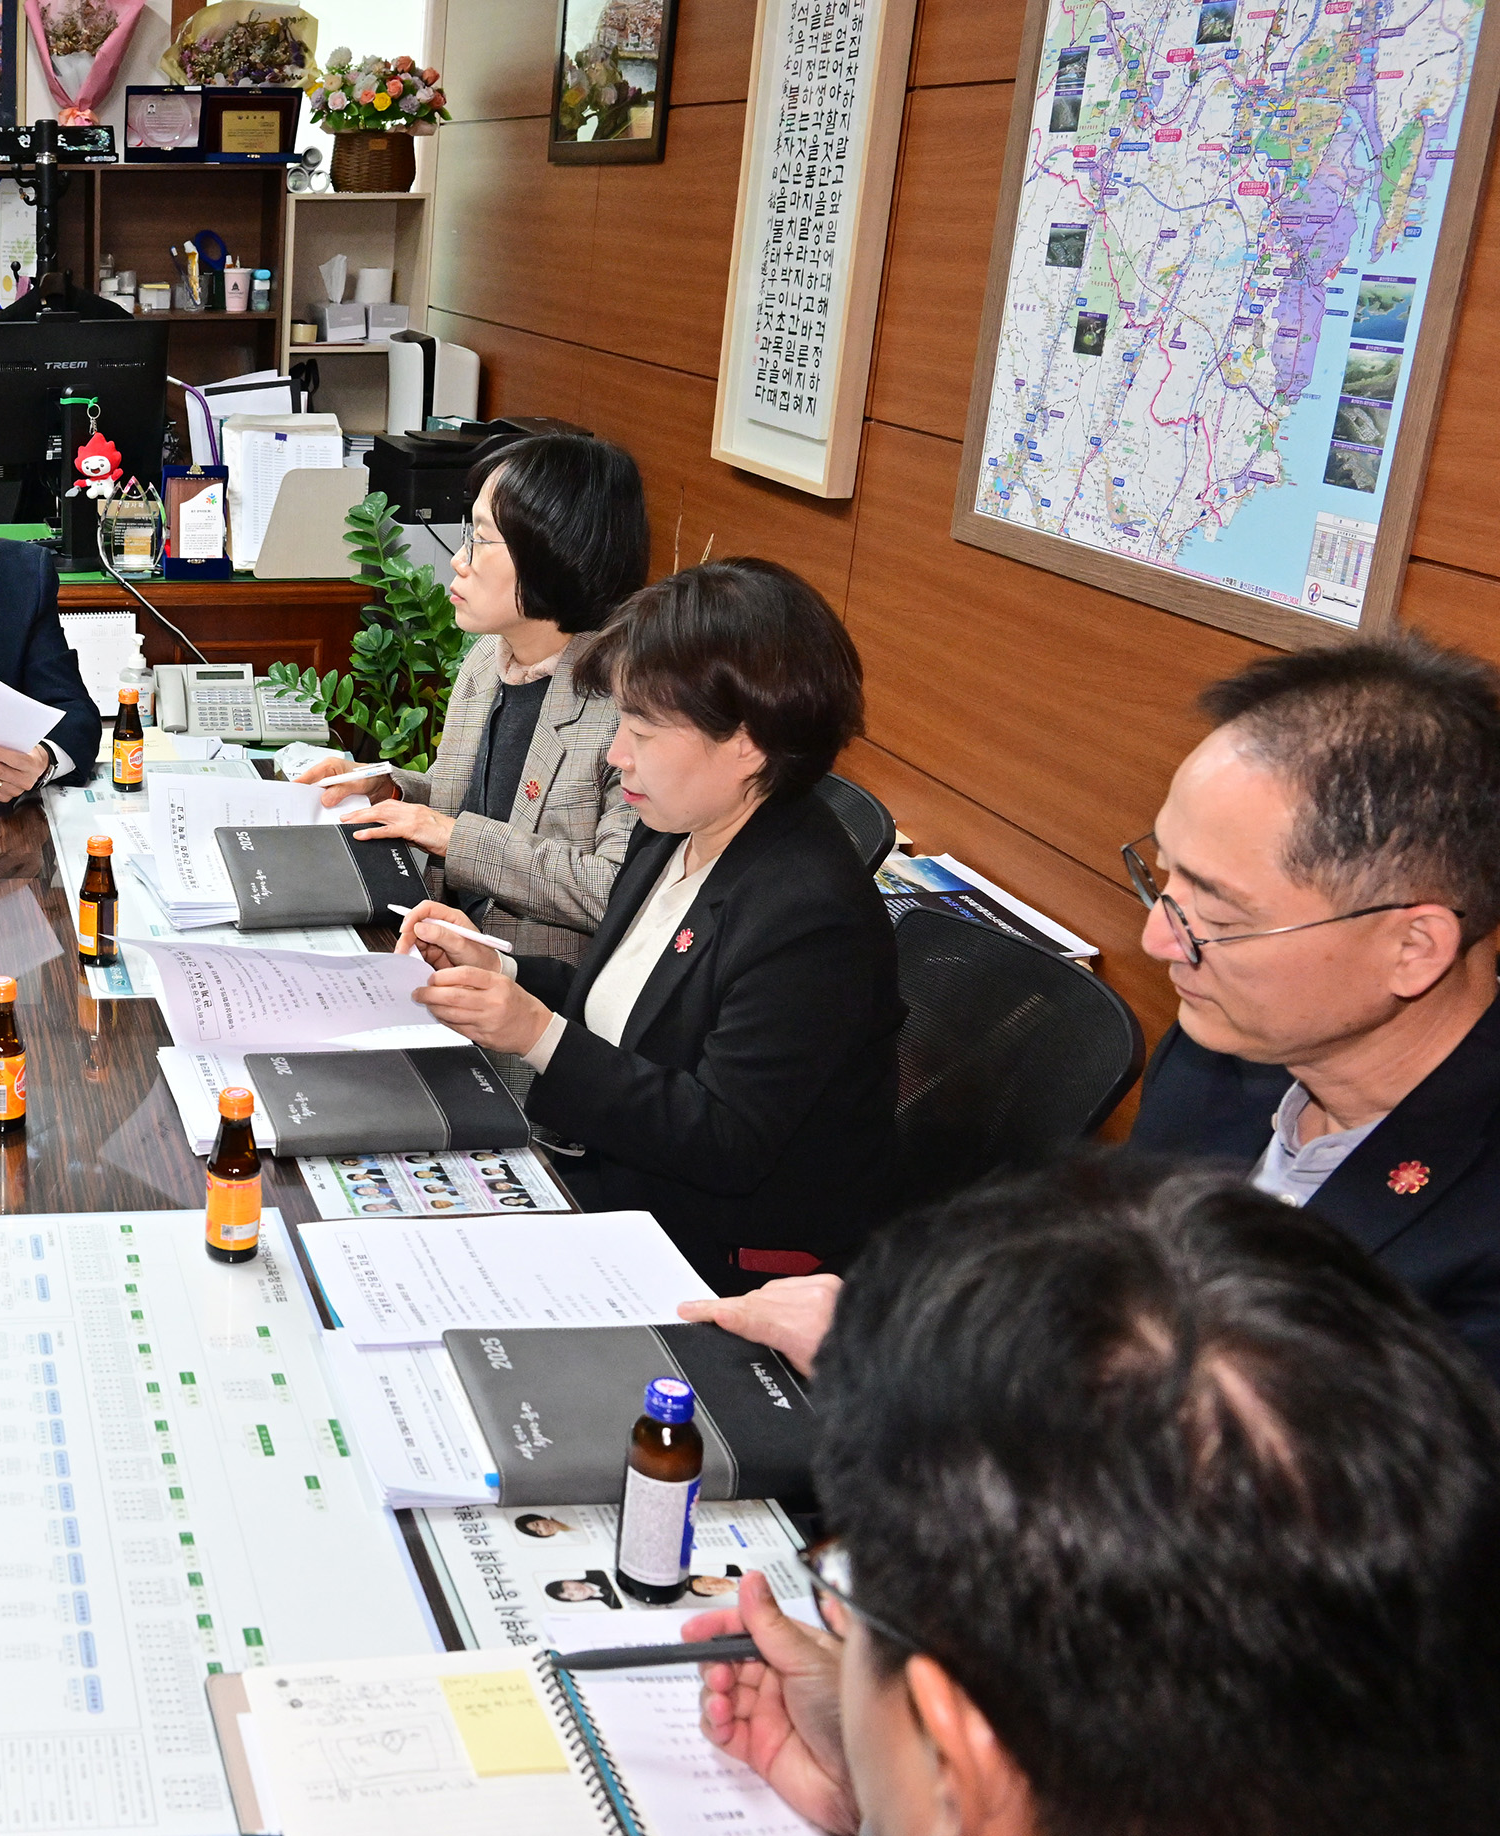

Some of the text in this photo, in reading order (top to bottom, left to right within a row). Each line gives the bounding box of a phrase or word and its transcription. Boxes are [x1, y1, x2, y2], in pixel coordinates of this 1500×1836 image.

[45, 361, 88, 370] TREEM
[236, 831, 254, 851] 2025
[270, 1057, 293, 1075] 2025
[480, 1338, 513, 1370] 2025
[454, 1506, 495, 1545] 의원현
[471, 1550, 519, 1601] 동구의회
